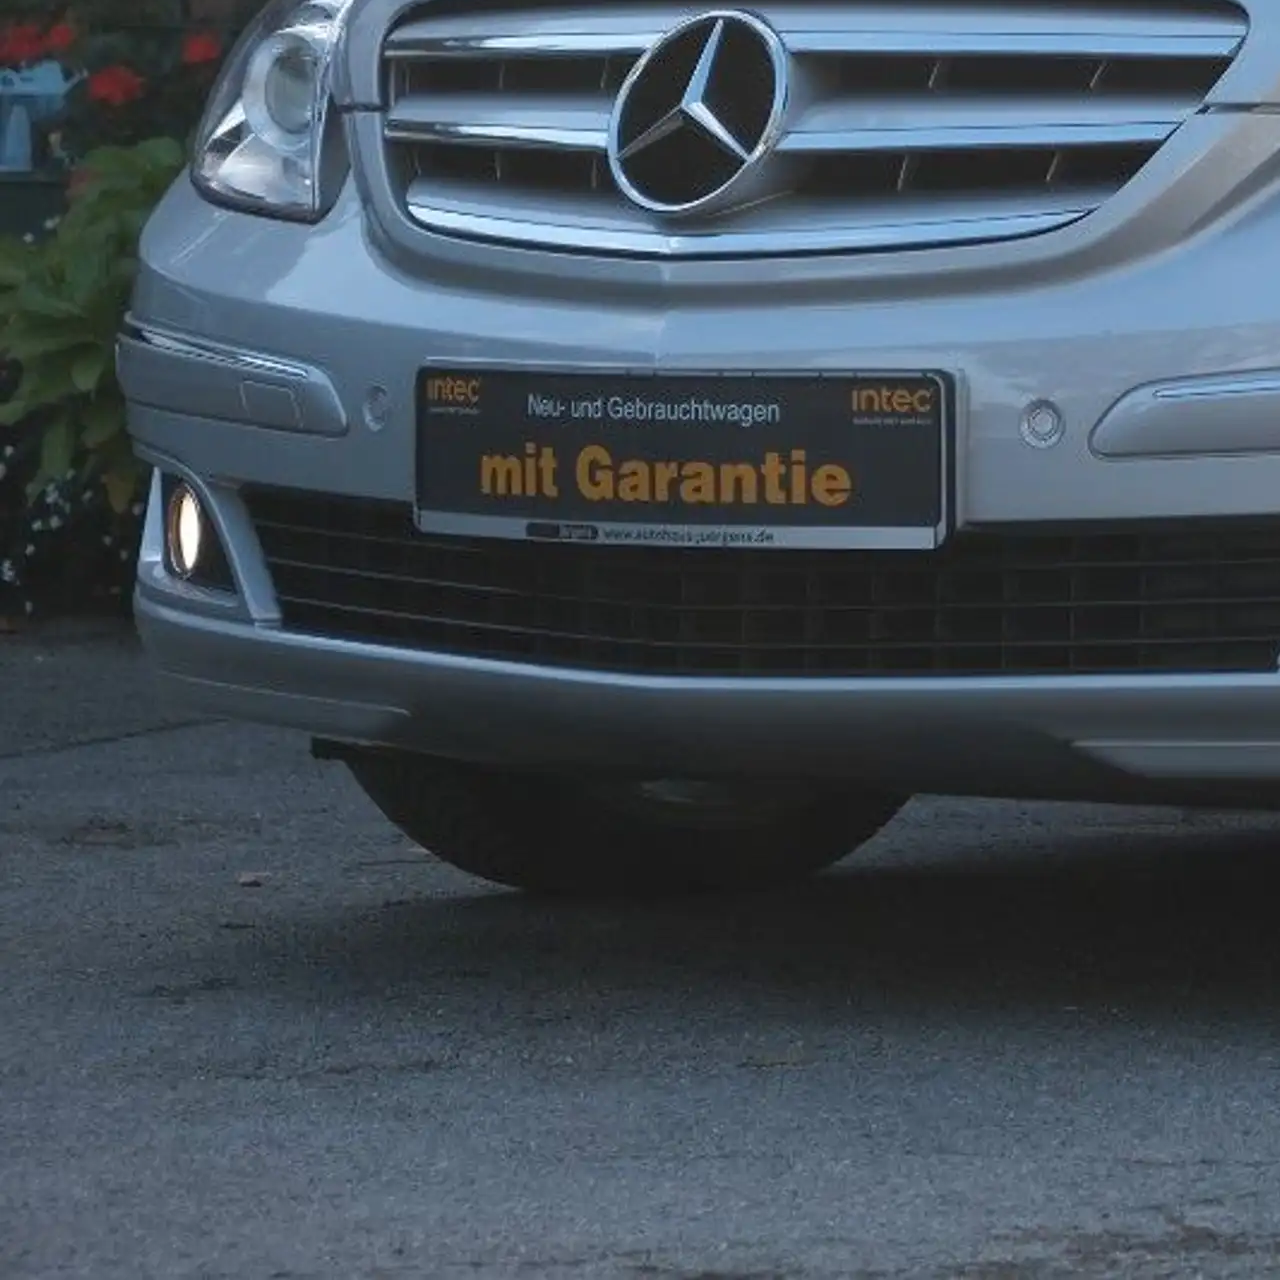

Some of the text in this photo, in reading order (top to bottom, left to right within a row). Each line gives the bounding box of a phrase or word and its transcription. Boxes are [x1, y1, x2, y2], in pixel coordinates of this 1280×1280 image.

[527, 393, 780, 426] Neu- und Gebrauchtwagen
[851, 386, 932, 413] intec
[480, 442, 852, 506] mit Garantie
